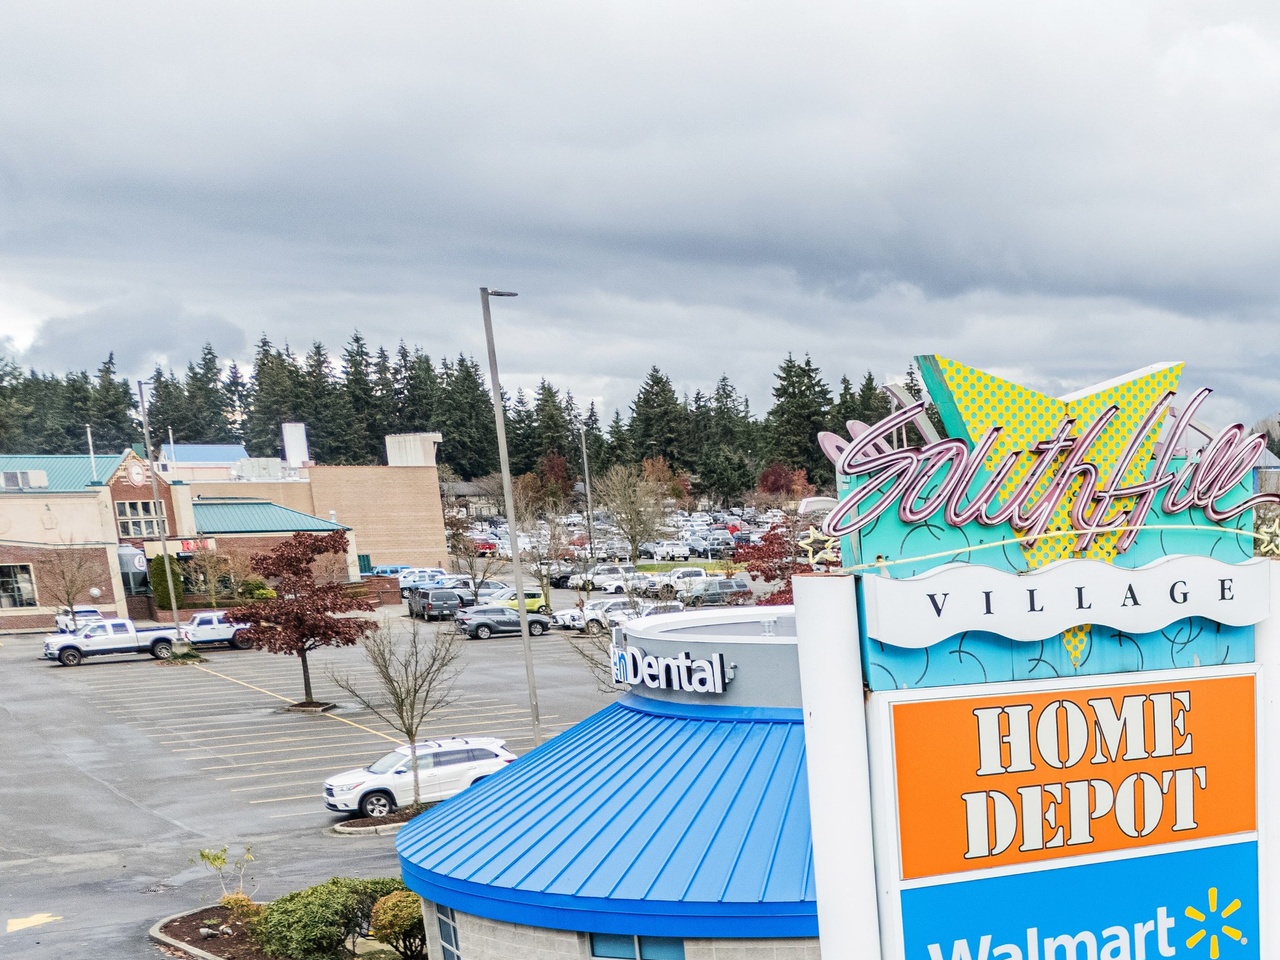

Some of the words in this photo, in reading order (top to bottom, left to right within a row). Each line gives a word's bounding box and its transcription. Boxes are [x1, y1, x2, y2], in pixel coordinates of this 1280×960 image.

[822, 401, 1130, 551] South
[927, 577, 1235, 618] VILLAGE
[973, 691, 1193, 776] HOME
[961, 766, 1207, 859] DEPOT
